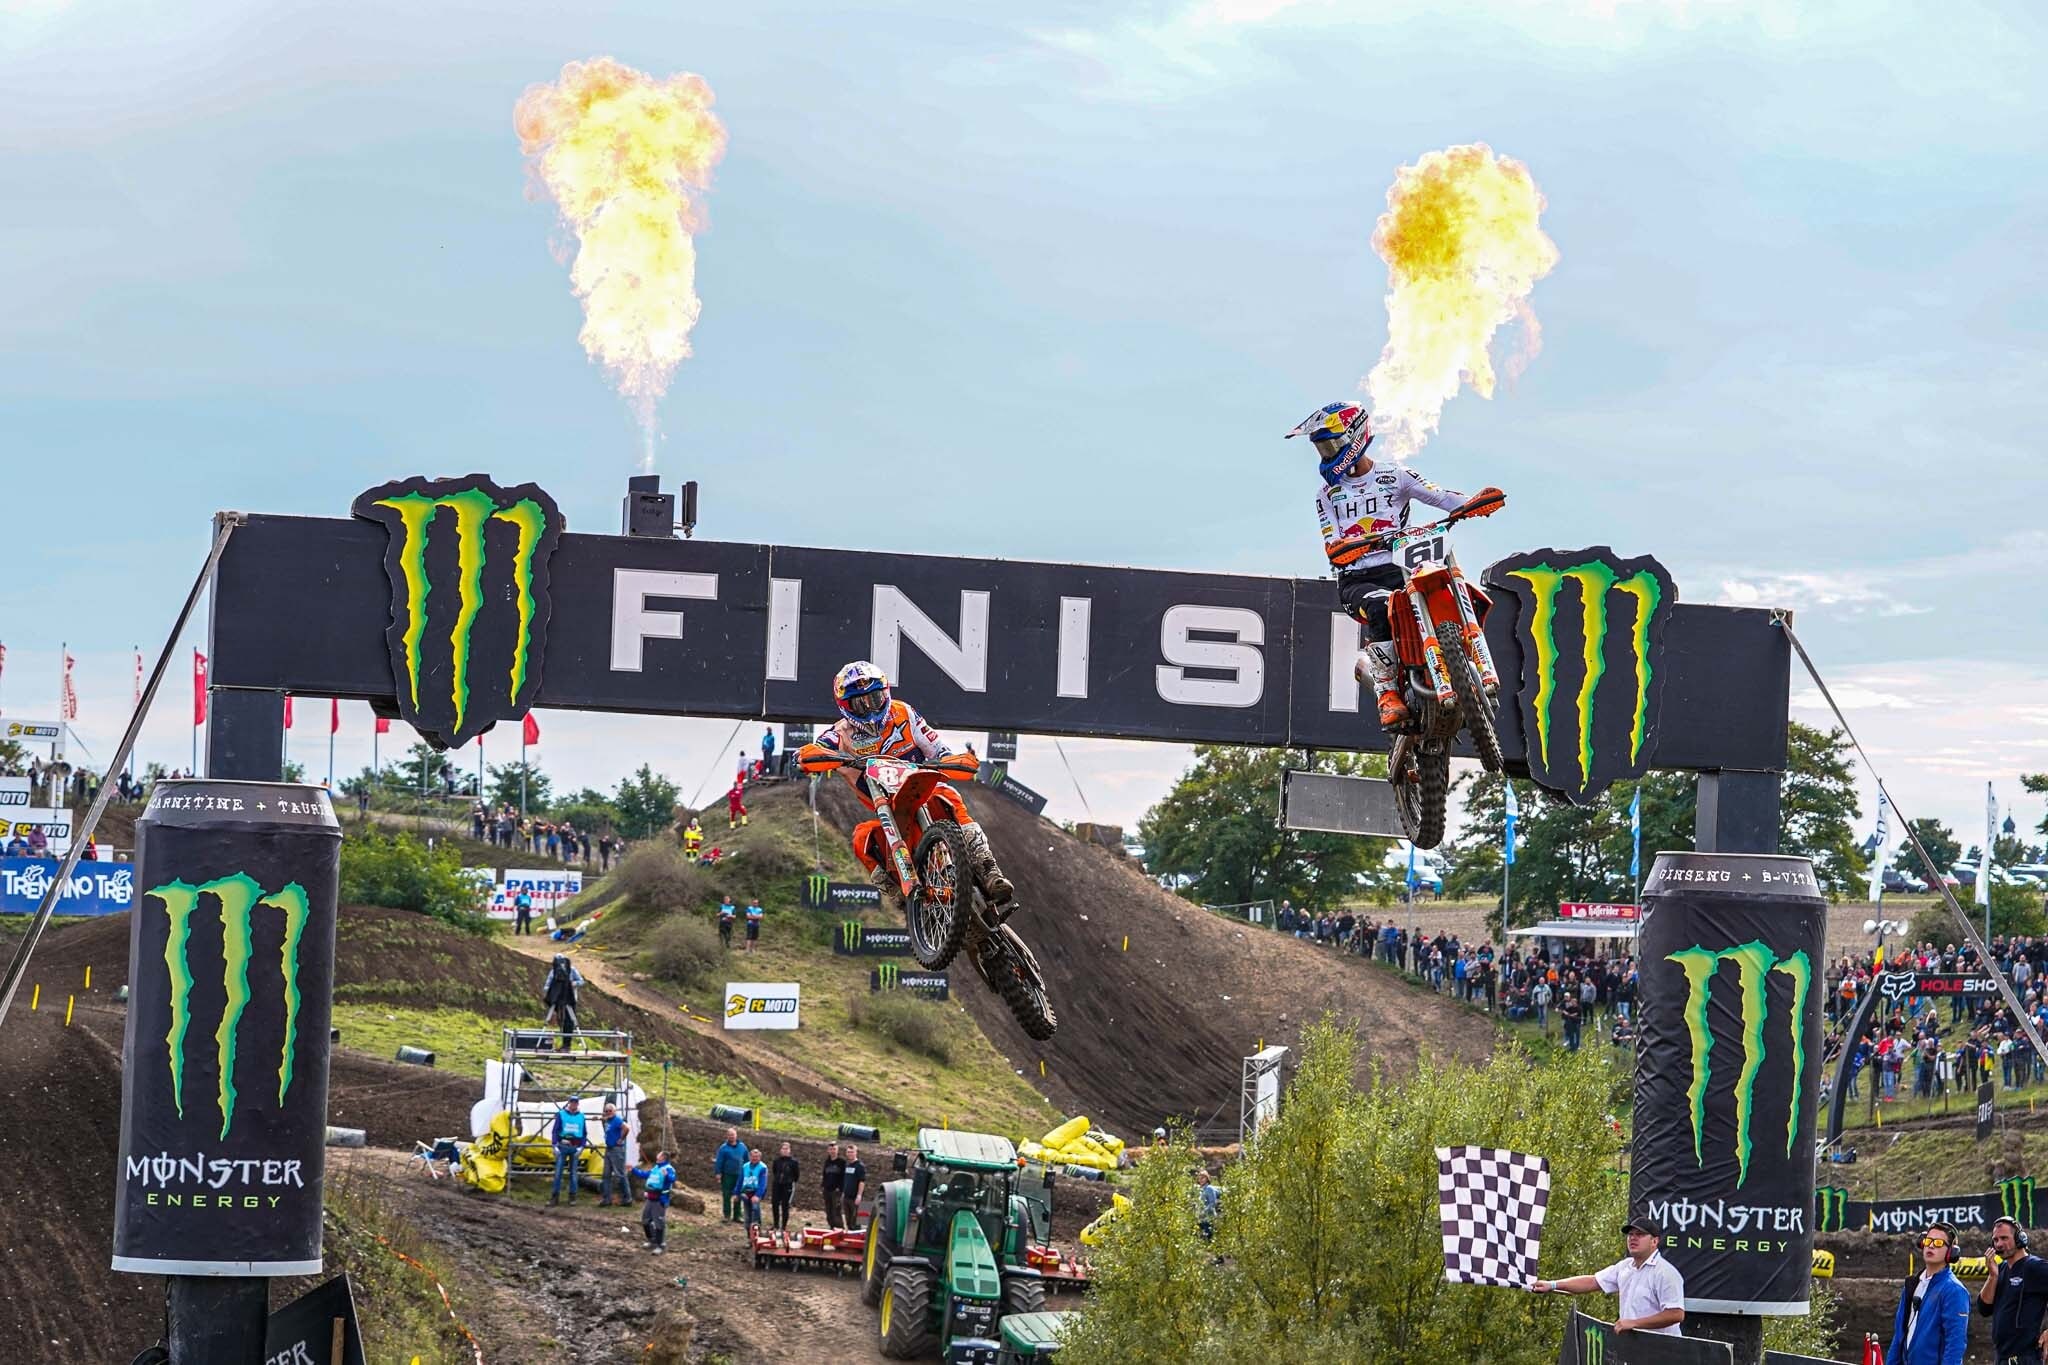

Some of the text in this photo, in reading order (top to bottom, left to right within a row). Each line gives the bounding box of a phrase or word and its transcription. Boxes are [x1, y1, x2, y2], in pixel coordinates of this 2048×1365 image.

[1405, 536, 1444, 569] 61
[36, 728, 57, 737] MOTO
[0, 792, 27, 804] OTO
[1659, 869, 1731, 882] GINSENG
[2, 870, 94, 900] TRENINO
[506, 880, 579, 892] PARTS
[832, 888, 879, 899] MONSTER
[901, 976, 947, 988] MONSTER
[1921, 979, 1998, 992] HOLESHO
[750, 1000, 795, 1012] FC MOTO
[126, 1151, 304, 1189] MONSTER
[147, 1194, 280, 1208] ENERGY
[1648, 1197, 1804, 1234] MONSTER
[1871, 1205, 1985, 1233] MONSTER
[1666, 1235, 1787, 1253] ENERGY
